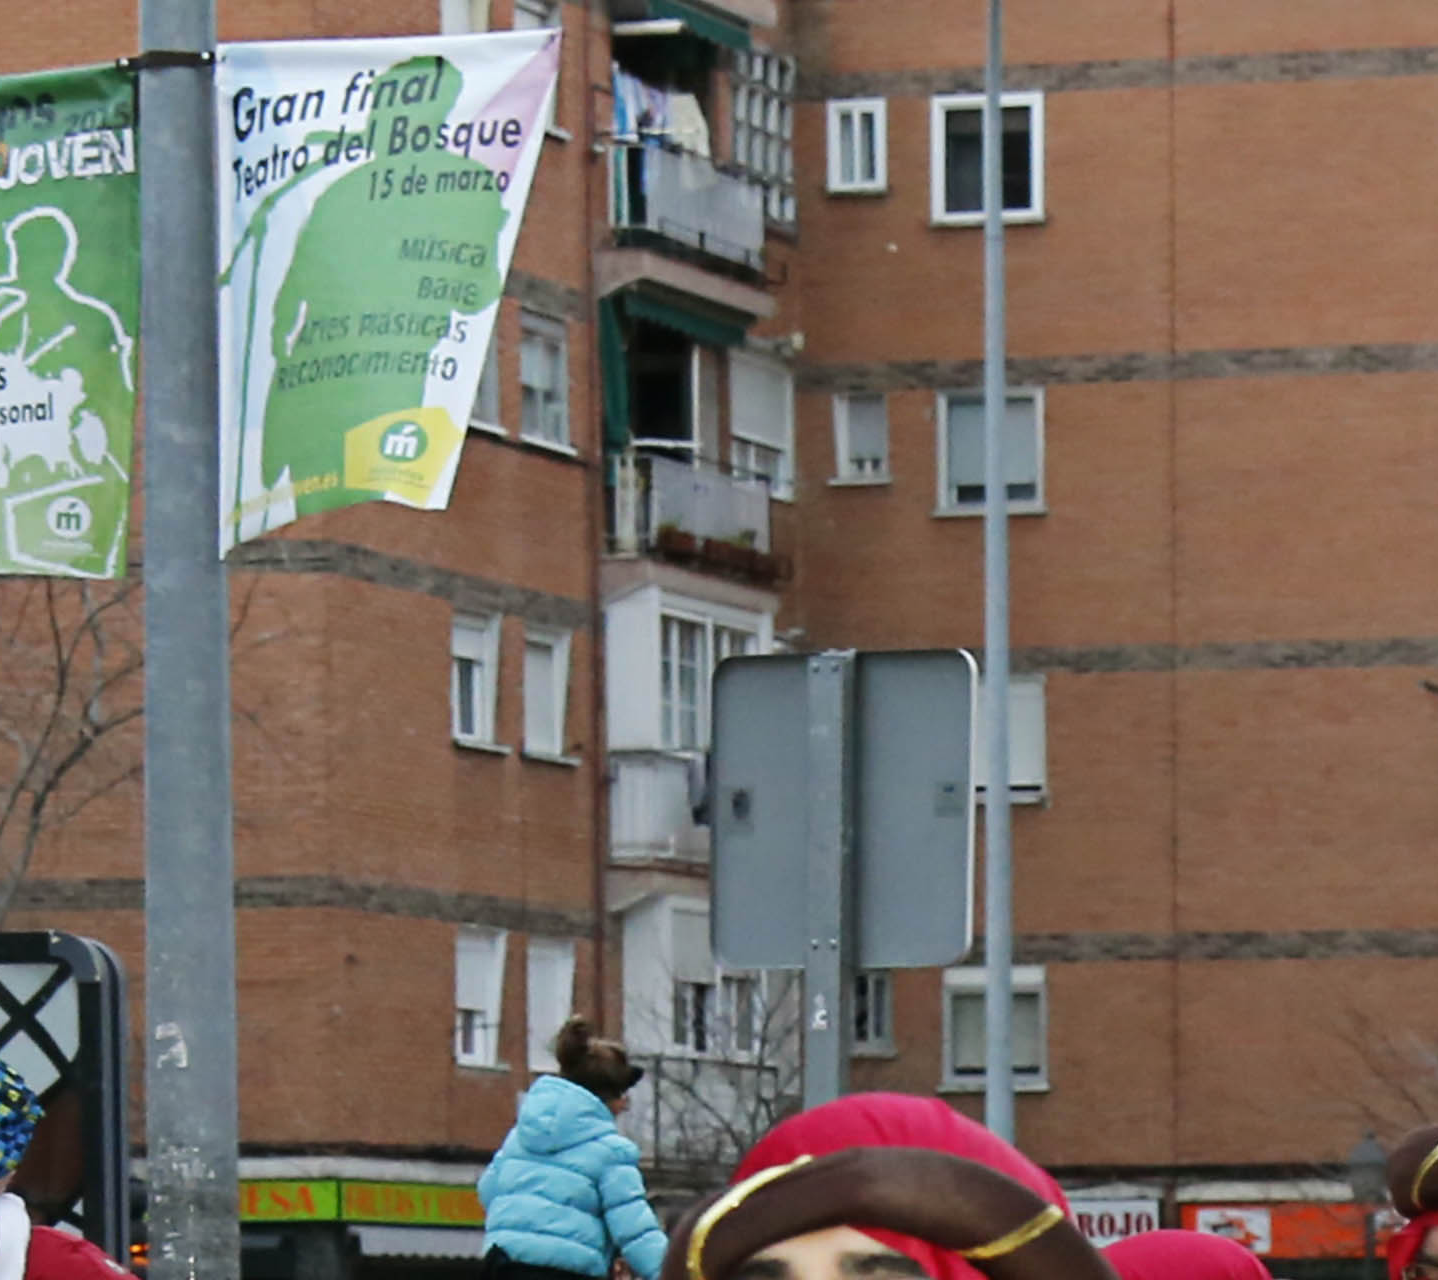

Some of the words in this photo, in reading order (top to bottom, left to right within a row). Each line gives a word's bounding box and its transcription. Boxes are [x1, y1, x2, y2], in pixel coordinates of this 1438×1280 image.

[233, 87, 325, 143] Gran
[341, 56, 445, 114] final
[233, 142, 309, 203] Teatro
[323, 118, 375, 167] del
[388, 116, 522, 158] Bosque
[369, 169, 396, 201] 15
[401, 164, 428, 197] de
[435, 169, 510, 194] marzo
